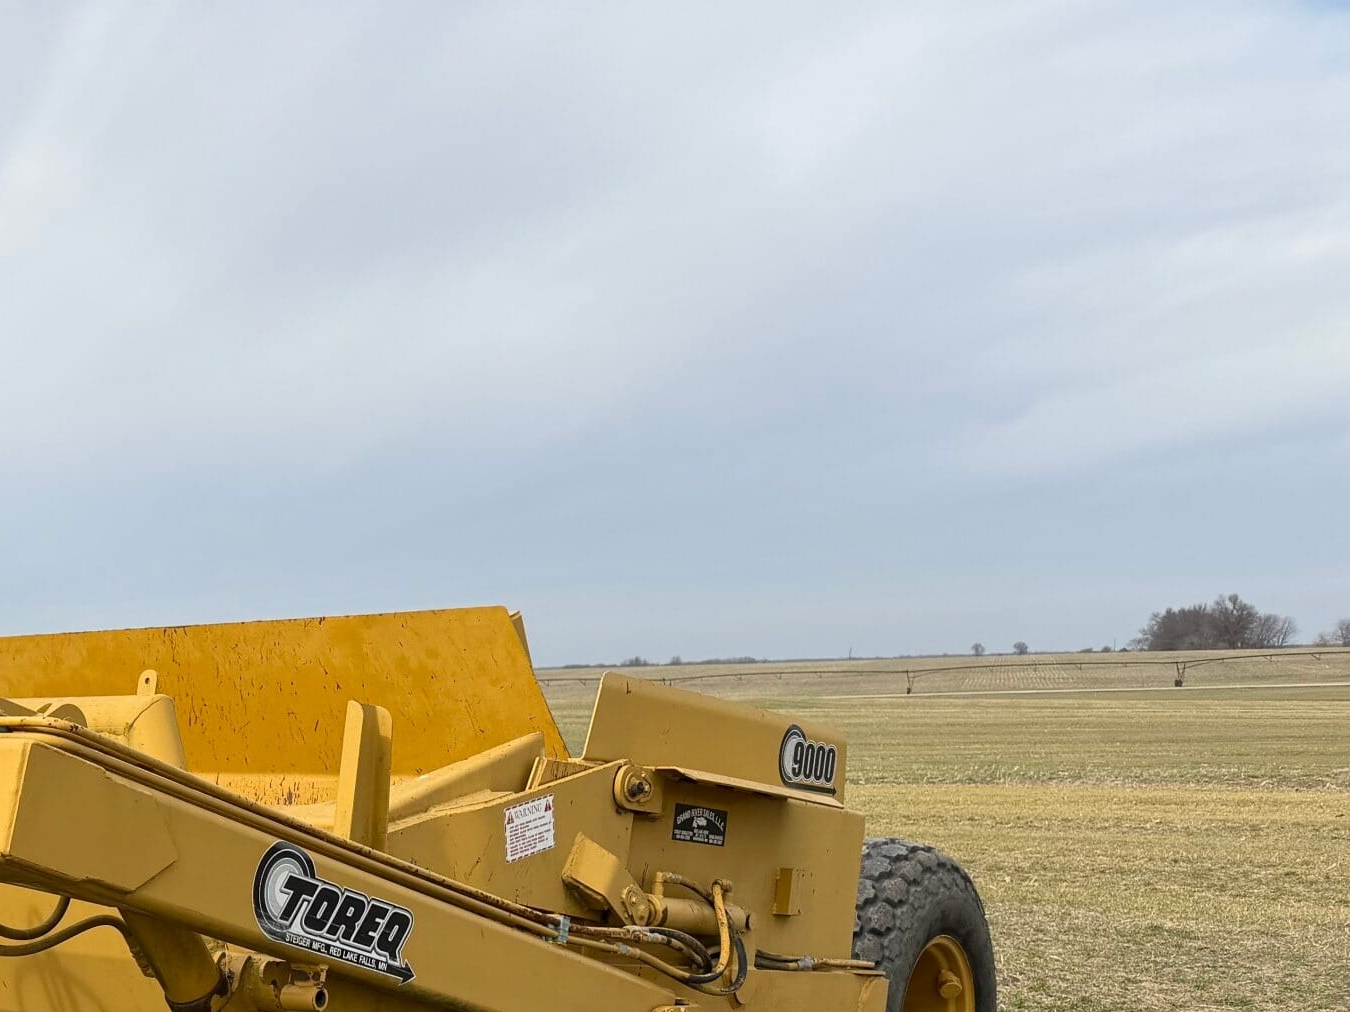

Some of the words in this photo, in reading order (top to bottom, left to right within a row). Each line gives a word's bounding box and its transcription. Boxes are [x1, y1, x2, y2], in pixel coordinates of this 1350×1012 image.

[791, 741, 836, 783] 9000
[514, 803, 542, 819] WARNING
[278, 872, 413, 964] TOREQ
[285, 933, 311, 947] STEIGER
[329, 946, 342, 957] RED
[342, 949, 358, 962] LAKE
[359, 955, 377, 969] FALLS,
[378, 960, 388, 971] MN
